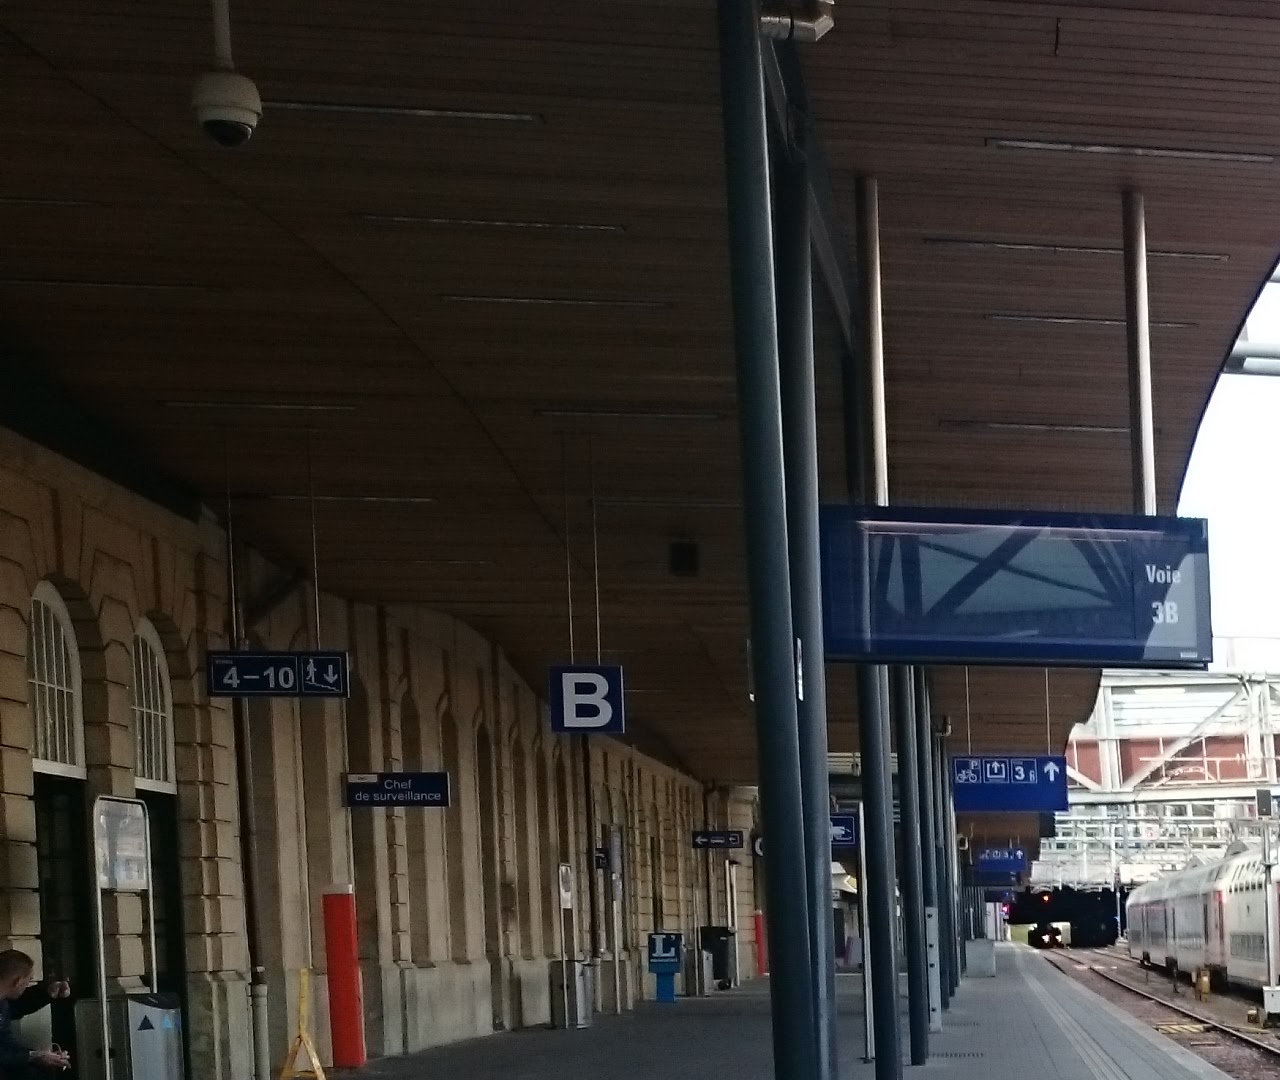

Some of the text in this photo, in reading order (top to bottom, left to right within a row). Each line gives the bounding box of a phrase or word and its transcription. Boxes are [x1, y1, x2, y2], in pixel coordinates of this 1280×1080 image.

[1145, 564, 1182, 583] Voie
[1152, 601, 1179, 624] 3B
[561, 672, 613, 728] B
[1014, 766, 1025, 781] 3
[384, 779, 412, 790] Chef
[355, 791, 442, 801] de surveillance
